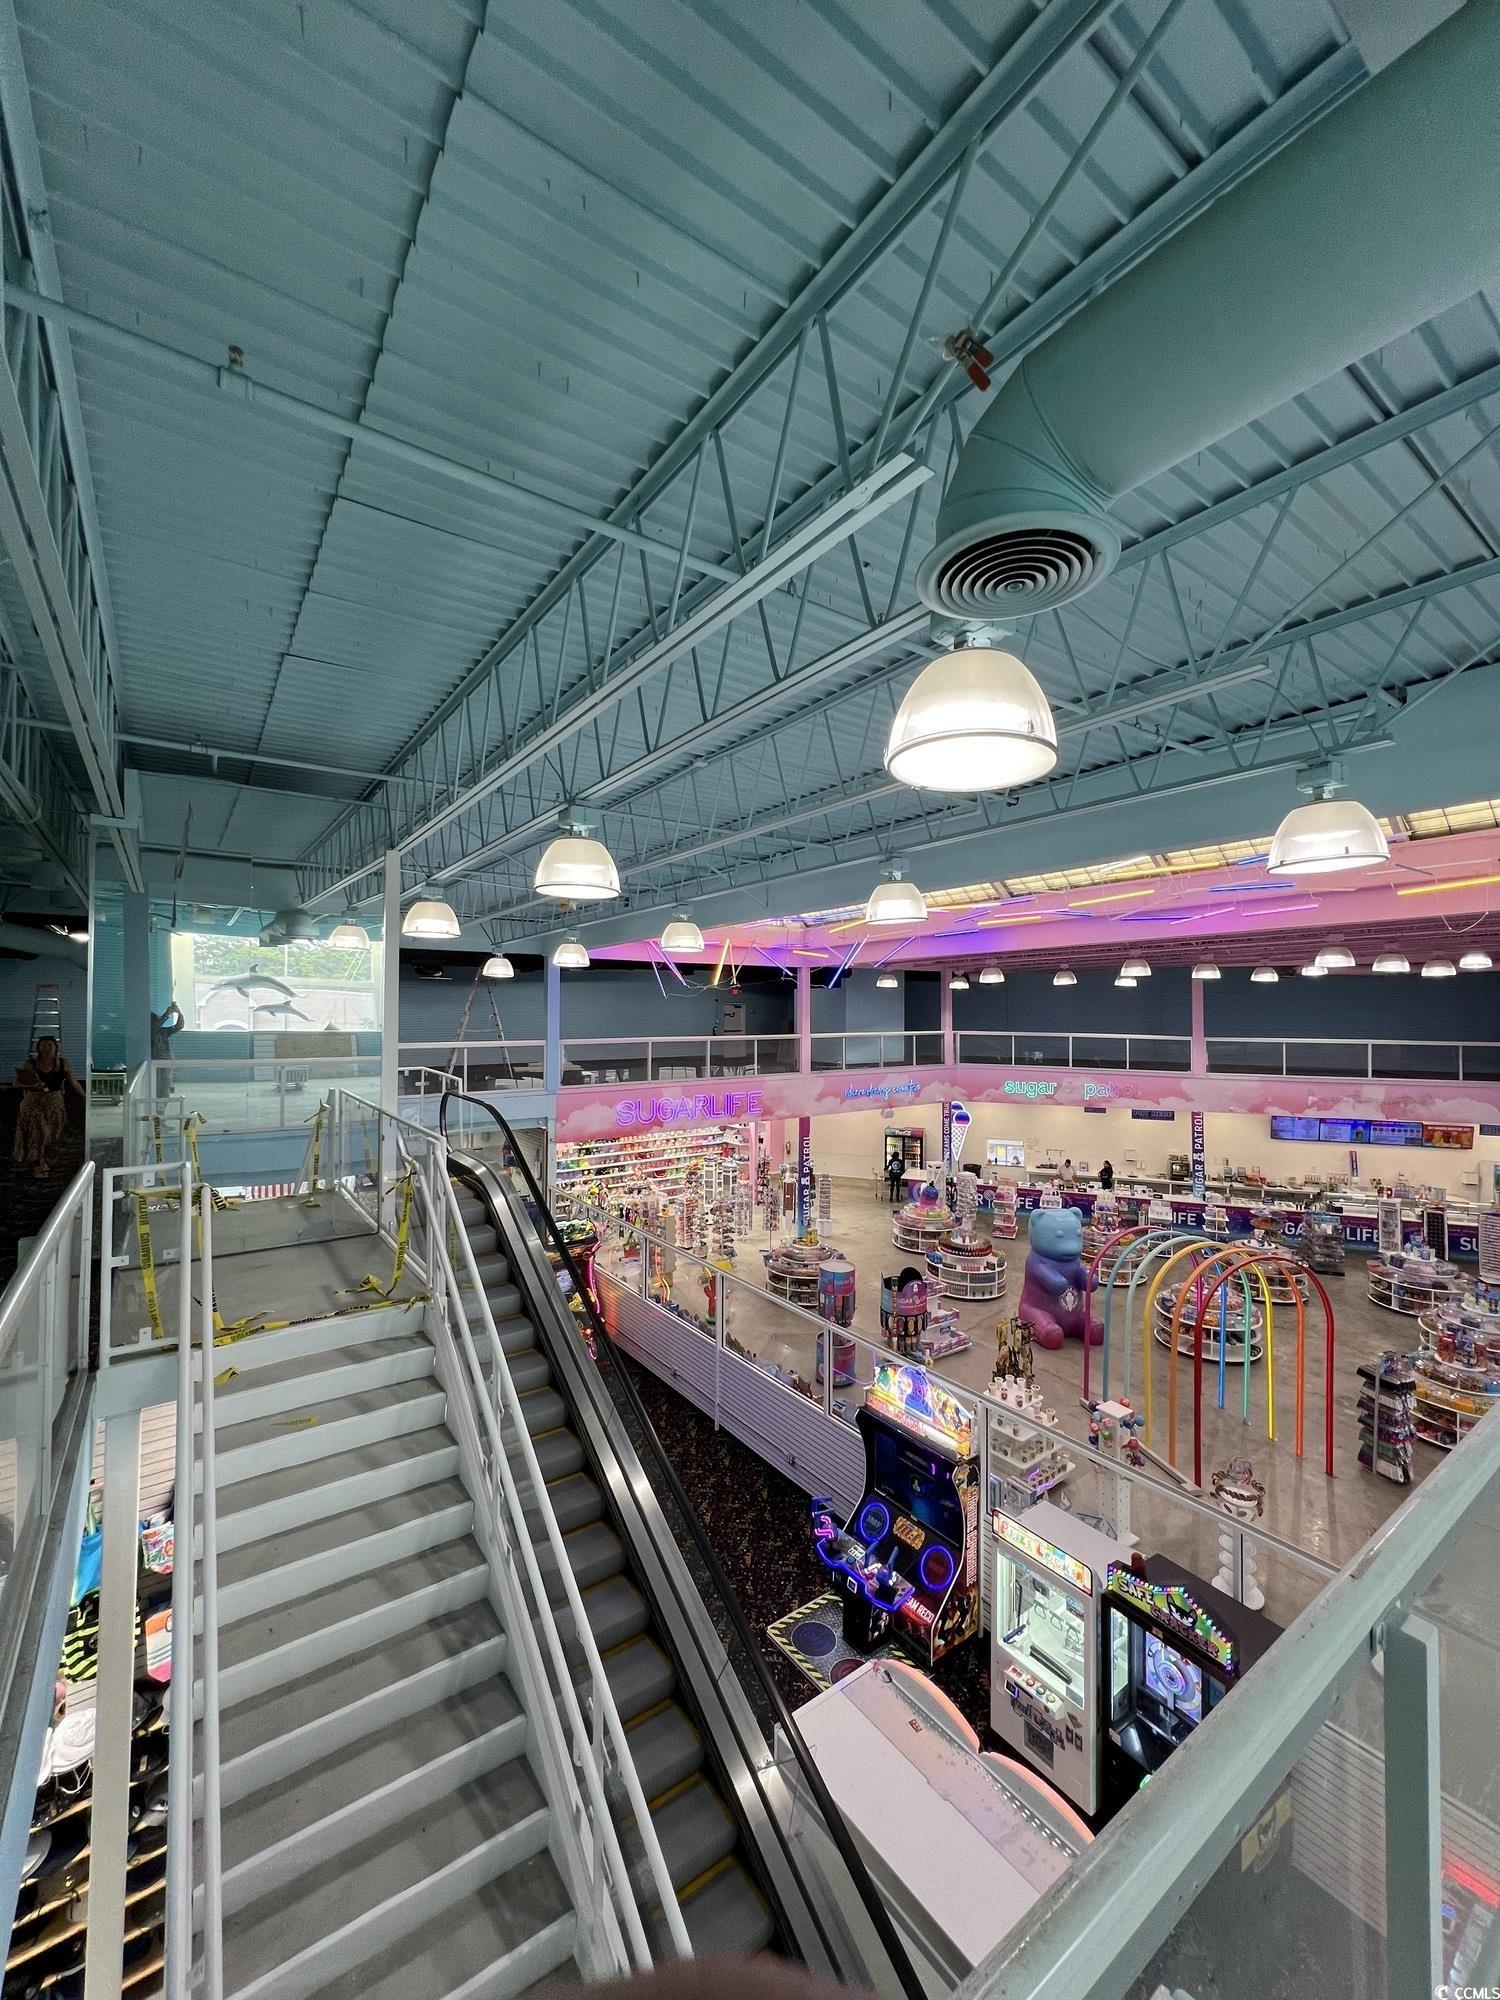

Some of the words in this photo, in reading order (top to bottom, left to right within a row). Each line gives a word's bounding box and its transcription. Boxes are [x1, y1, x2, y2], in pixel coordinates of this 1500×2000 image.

[1004, 1080, 1057, 1097] sugar
[616, 1090, 763, 1126] SUGARLIFE
[1194, 1112, 1204, 1150] PATROL
[803, 1136, 811, 1174] PATROL
[1195, 1164, 1205, 1198] SUGAR
[802, 1189, 811, 1228] SUGAR
[1173, 1212, 1198, 1226] IFE
[1117, 1578, 1155, 1606] SAFE
